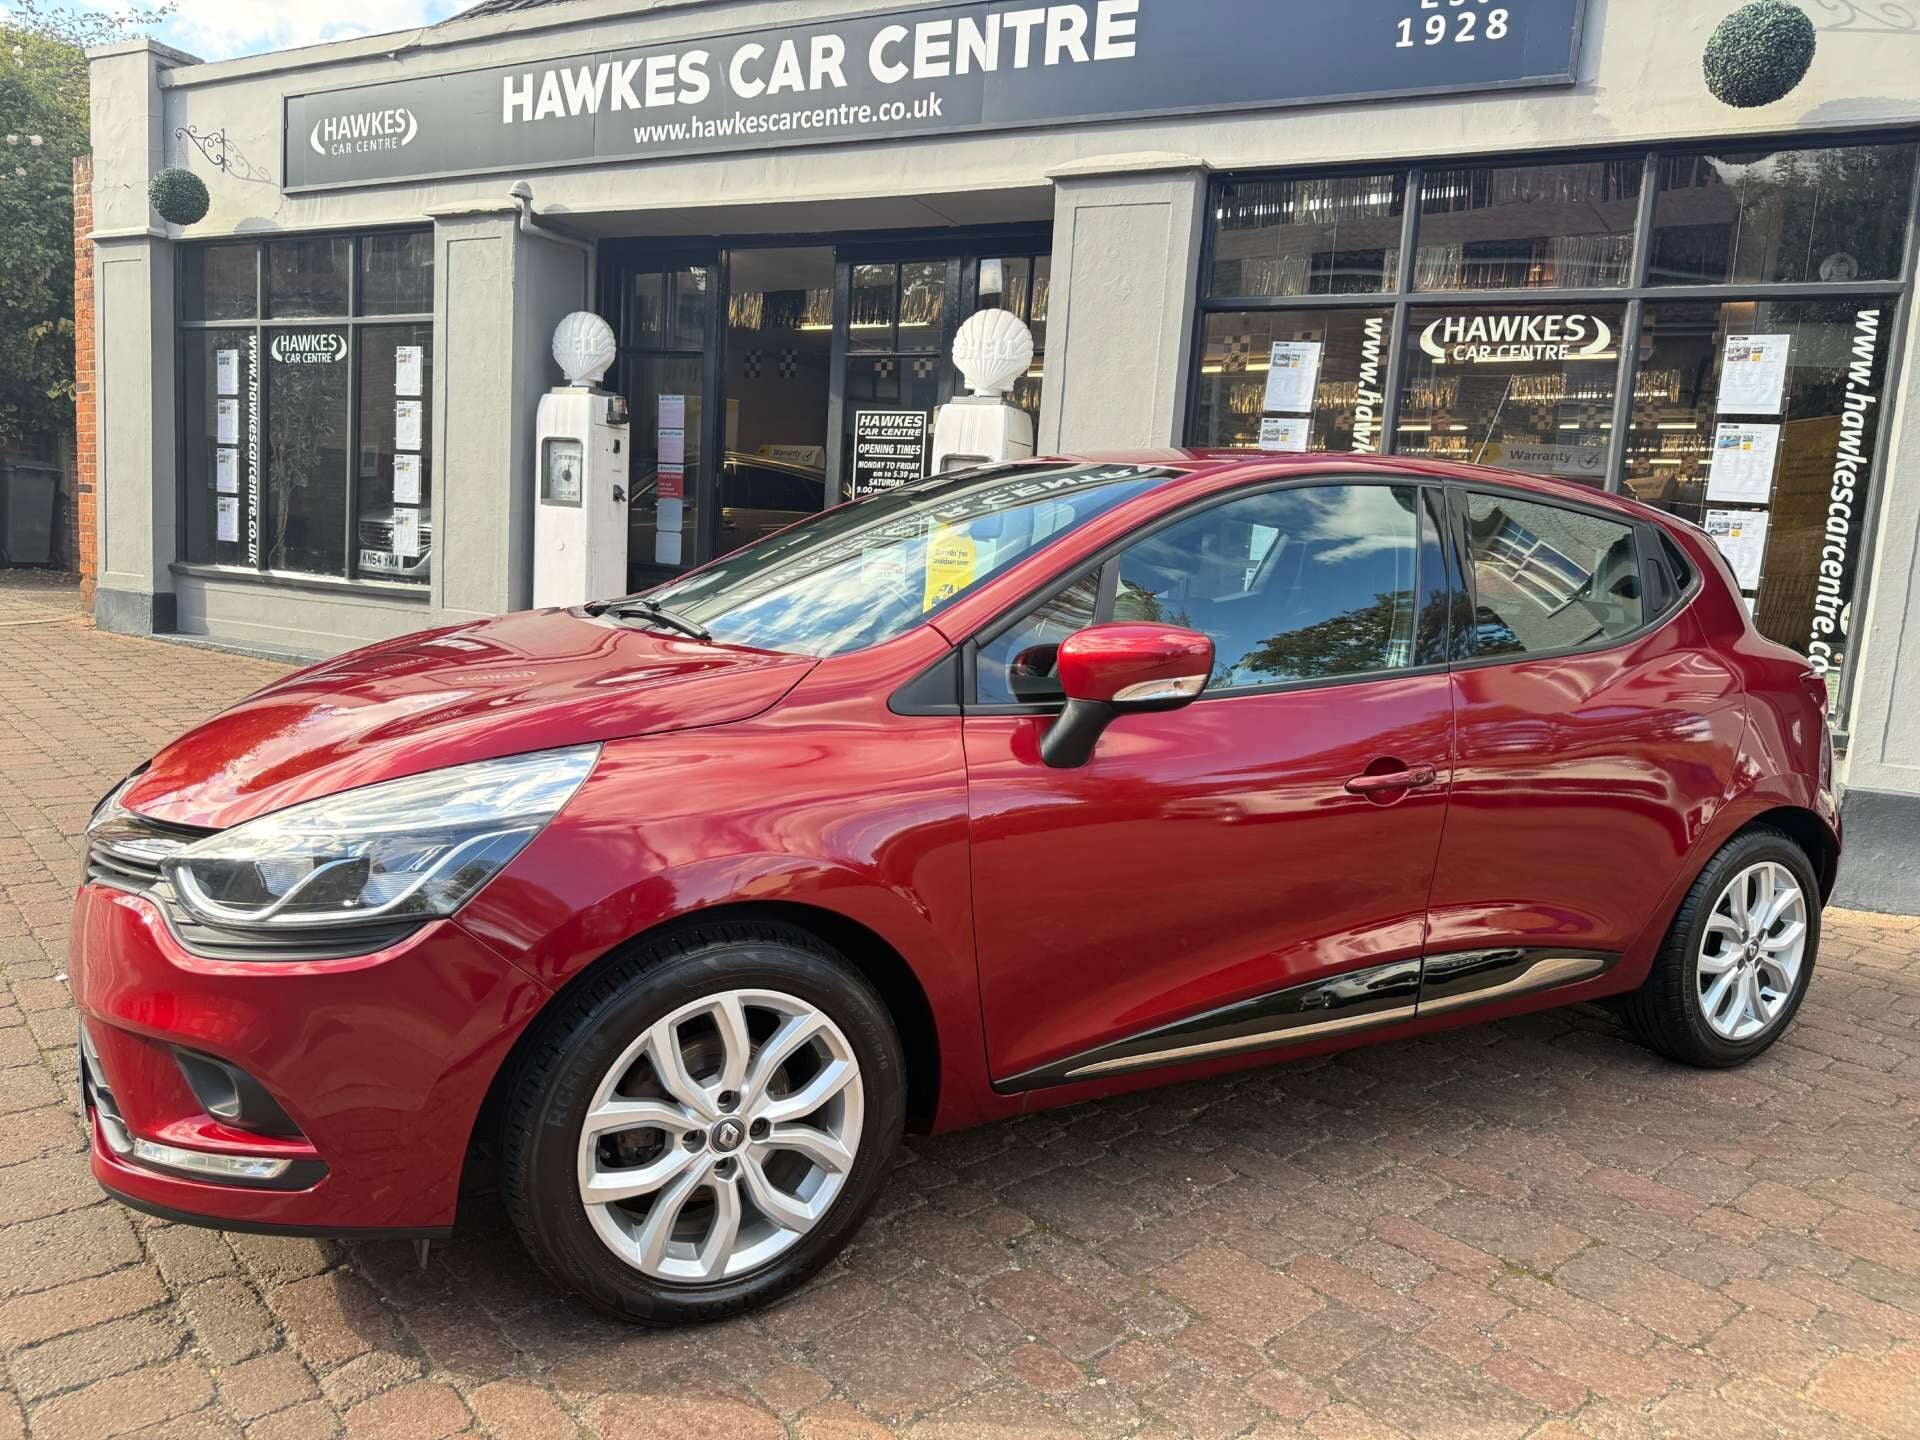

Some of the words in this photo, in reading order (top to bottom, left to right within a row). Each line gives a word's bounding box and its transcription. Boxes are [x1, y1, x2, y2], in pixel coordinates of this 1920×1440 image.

[1395, 8, 1509, 48] 1928
[502, 50, 710, 124] HAWKES
[729, 34, 848, 99] CAR
[868, 0, 1140, 84] CENTRE
[324, 108, 406, 142] HAWKES
[633, 91, 942, 144] www.hawkescarcentre.co.uk
[331, 143, 352, 156] CAR
[356, 137, 398, 153] CENTRE
[1443, 314, 1587, 343] HAWKES
[280, 334, 337, 352] HAWKES
[1453, 344, 1489, 361] CAR
[1496, 343, 1571, 361] CENTRE
[285, 353, 301, 364] CAR
[302, 353, 332, 363] CENTRE
[860, 415, 923, 427] HAWKES
[858, 428, 879, 436] CAR
[881, 428, 922, 436] CENTRE
[858, 444, 895, 454] OPENING
[897, 445, 921, 455] TIMES
[1510, 450, 1573, 463] Warranty
[857, 461, 885, 469] MONDAY
[896, 462, 920, 470] FRIDAY
[868, 479, 905, 487] SATURDAY
